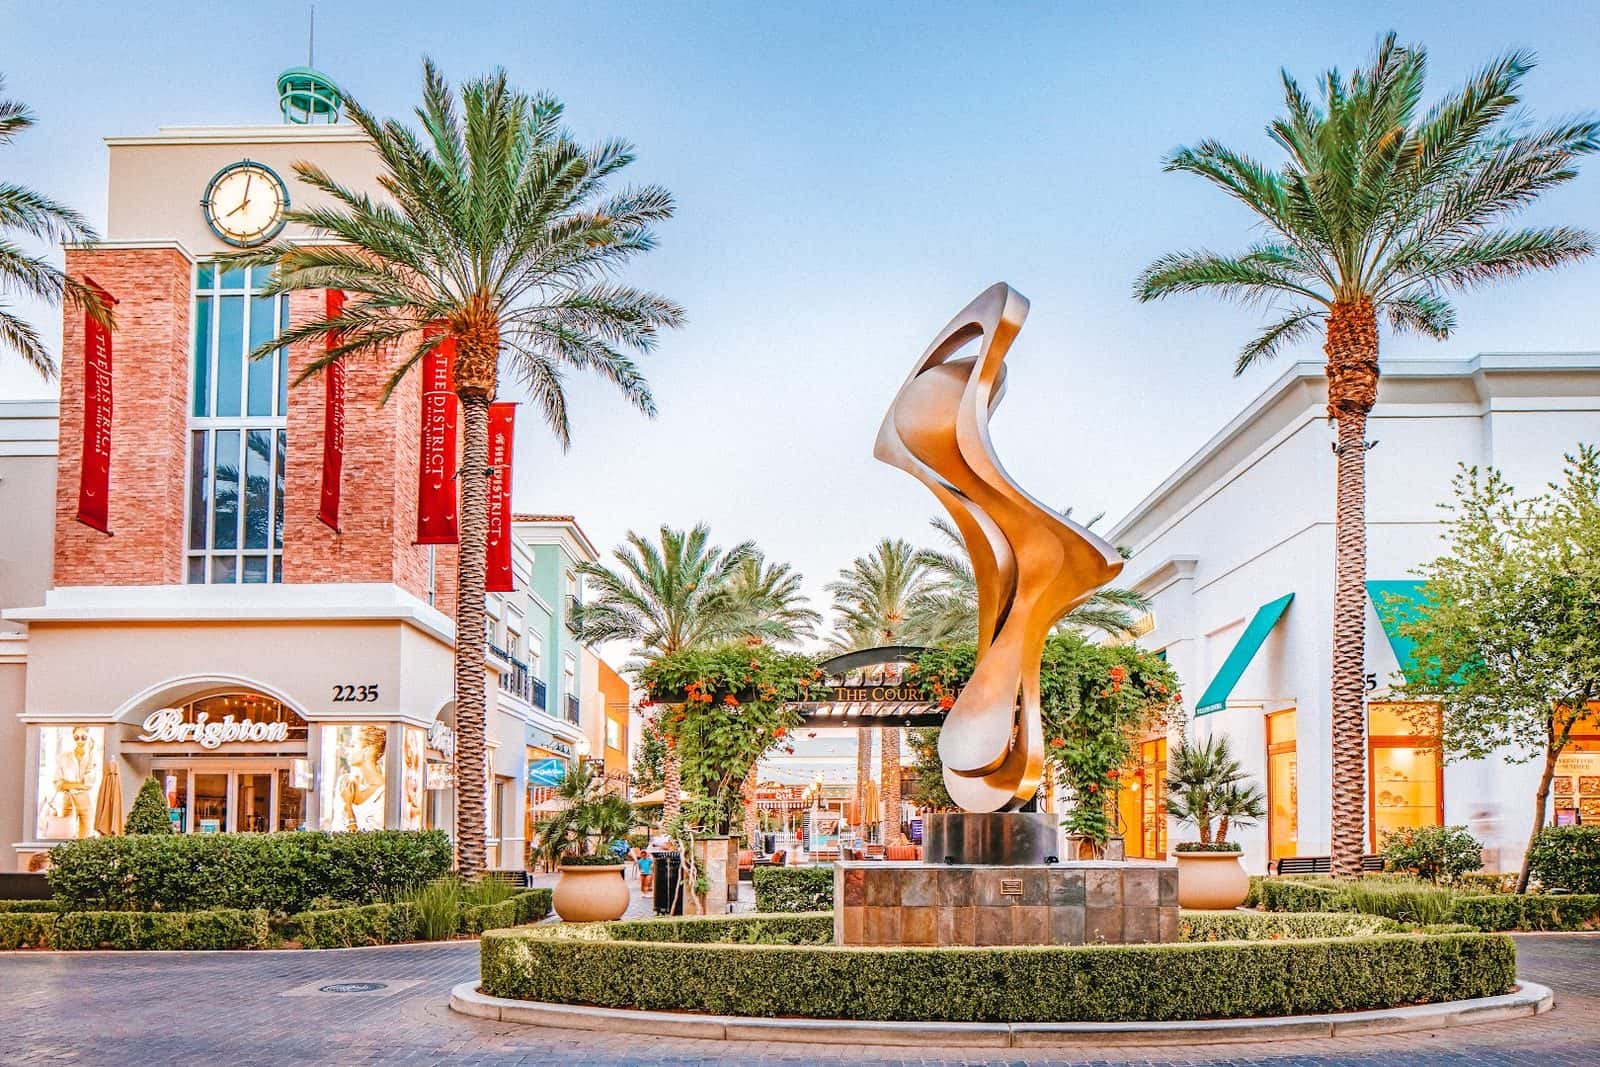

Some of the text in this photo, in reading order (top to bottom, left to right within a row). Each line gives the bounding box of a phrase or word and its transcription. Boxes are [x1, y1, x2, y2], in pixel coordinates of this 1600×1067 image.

[95, 334, 111, 457] THE DISTRICT
[431, 357, 448, 480] THE DISTRICT
[491, 468, 504, 539] DISTRICT
[332, 684, 379, 703] 2235
[834, 687, 868, 701] THE
[139, 708, 288, 748] Brighton
